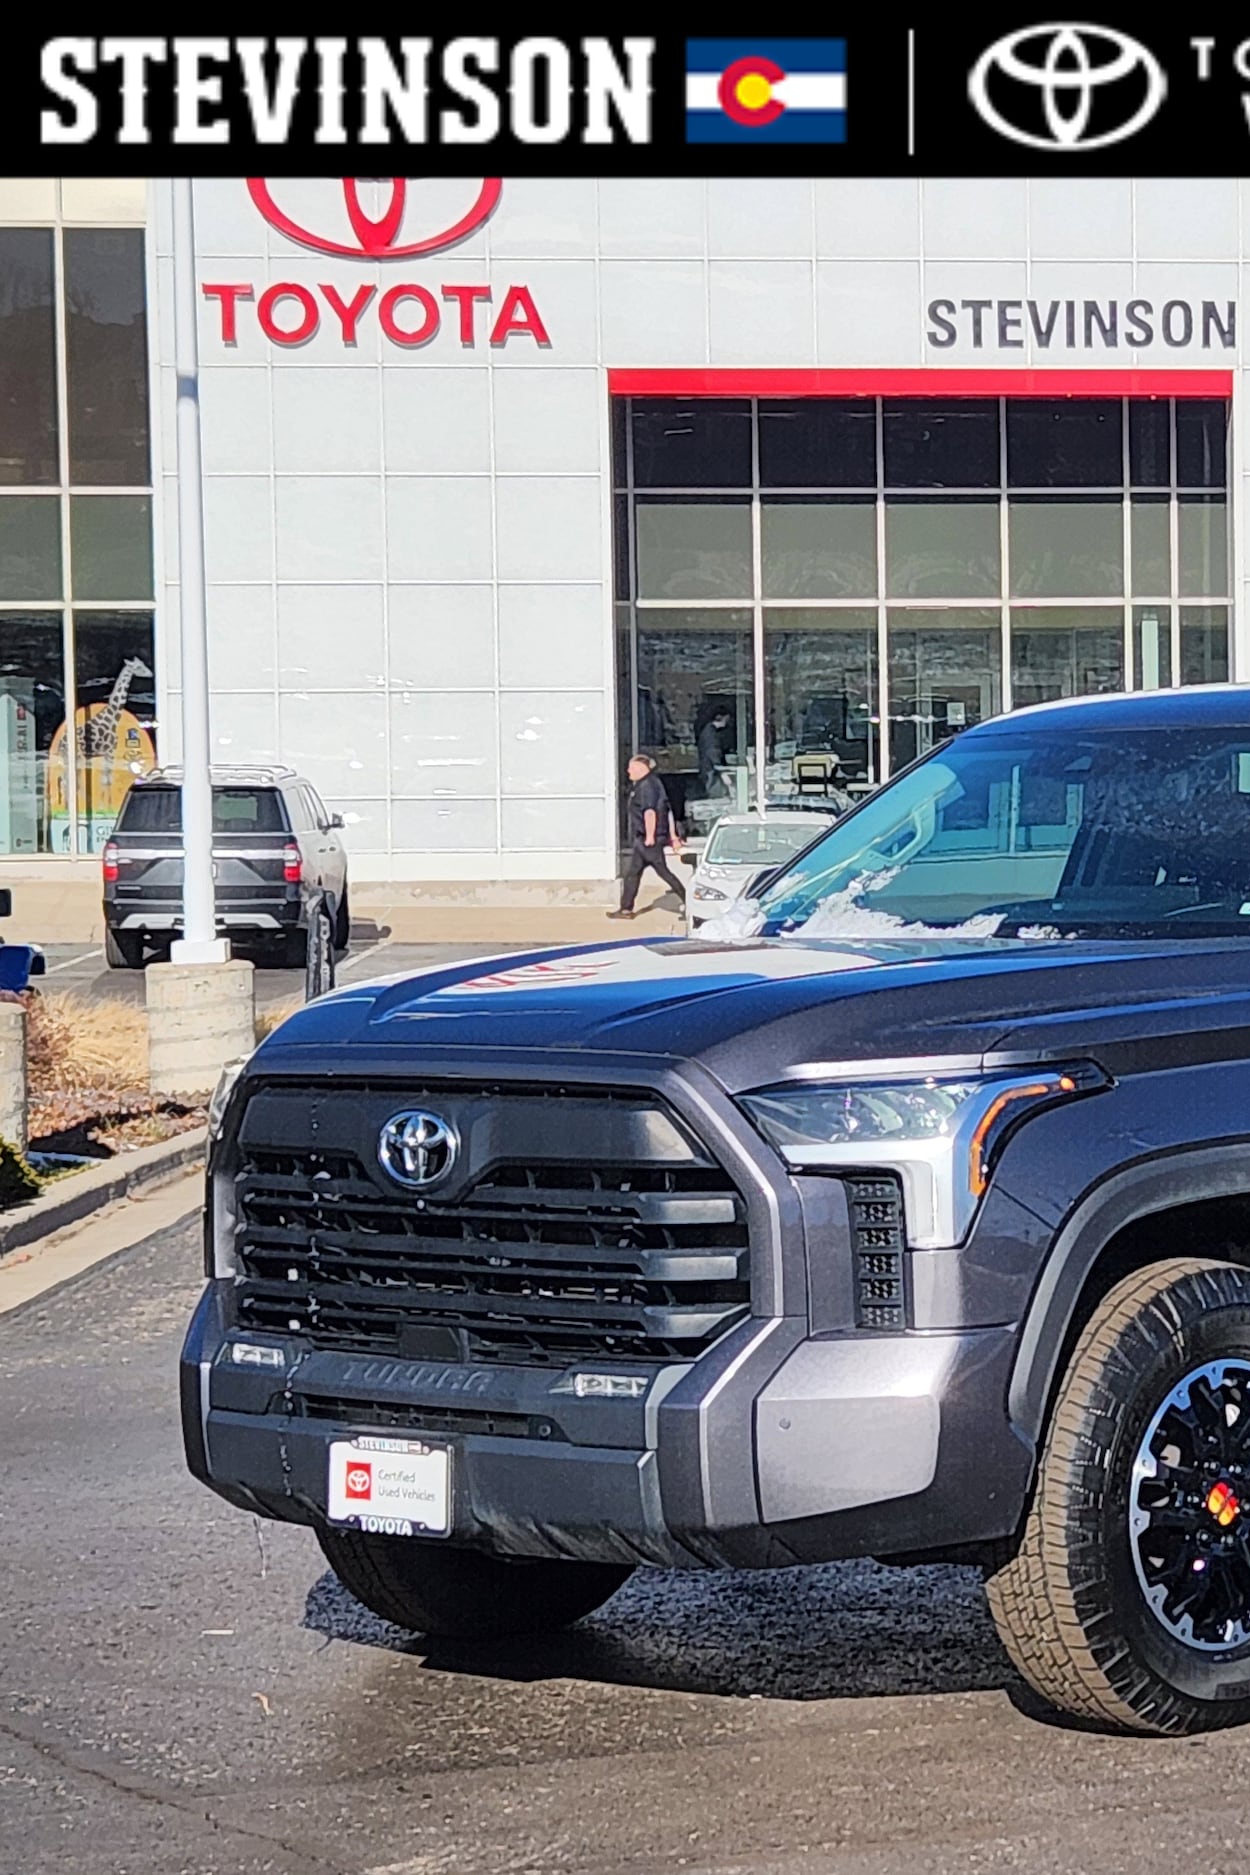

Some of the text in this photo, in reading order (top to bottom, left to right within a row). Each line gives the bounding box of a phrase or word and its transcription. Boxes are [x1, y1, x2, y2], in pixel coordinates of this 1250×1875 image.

[202, 282, 551, 347] TOYOTA
[927, 299, 1237, 349] STEVINSON
[342, 1361, 493, 1391] TUNDRA
[378, 1469, 416, 1483] Certified
[378, 1487, 436, 1501] Used Vehicles
[359, 1516, 413, 1536] TOYOTA
